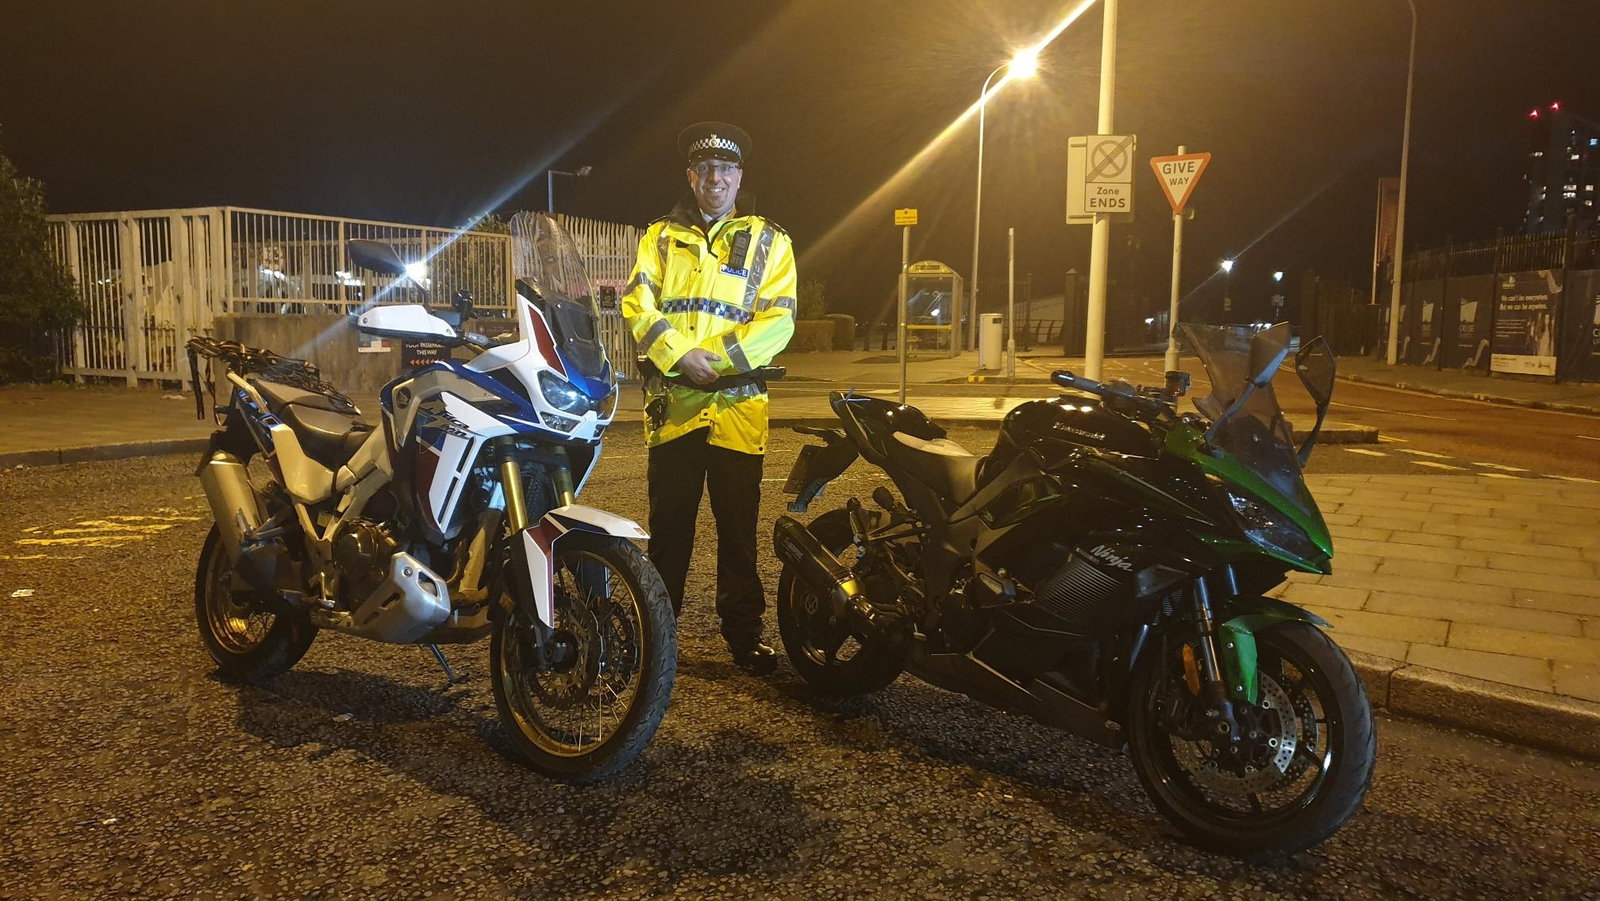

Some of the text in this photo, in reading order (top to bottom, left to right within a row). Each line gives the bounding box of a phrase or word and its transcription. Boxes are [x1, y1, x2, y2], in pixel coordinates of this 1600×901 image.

[1162, 161, 1195, 175] GIVE
[1169, 177, 1189, 186] WAY
[1096, 186, 1120, 195] Zone
[1090, 197, 1126, 208] ENDS
[1090, 544, 1133, 572] Ninja
